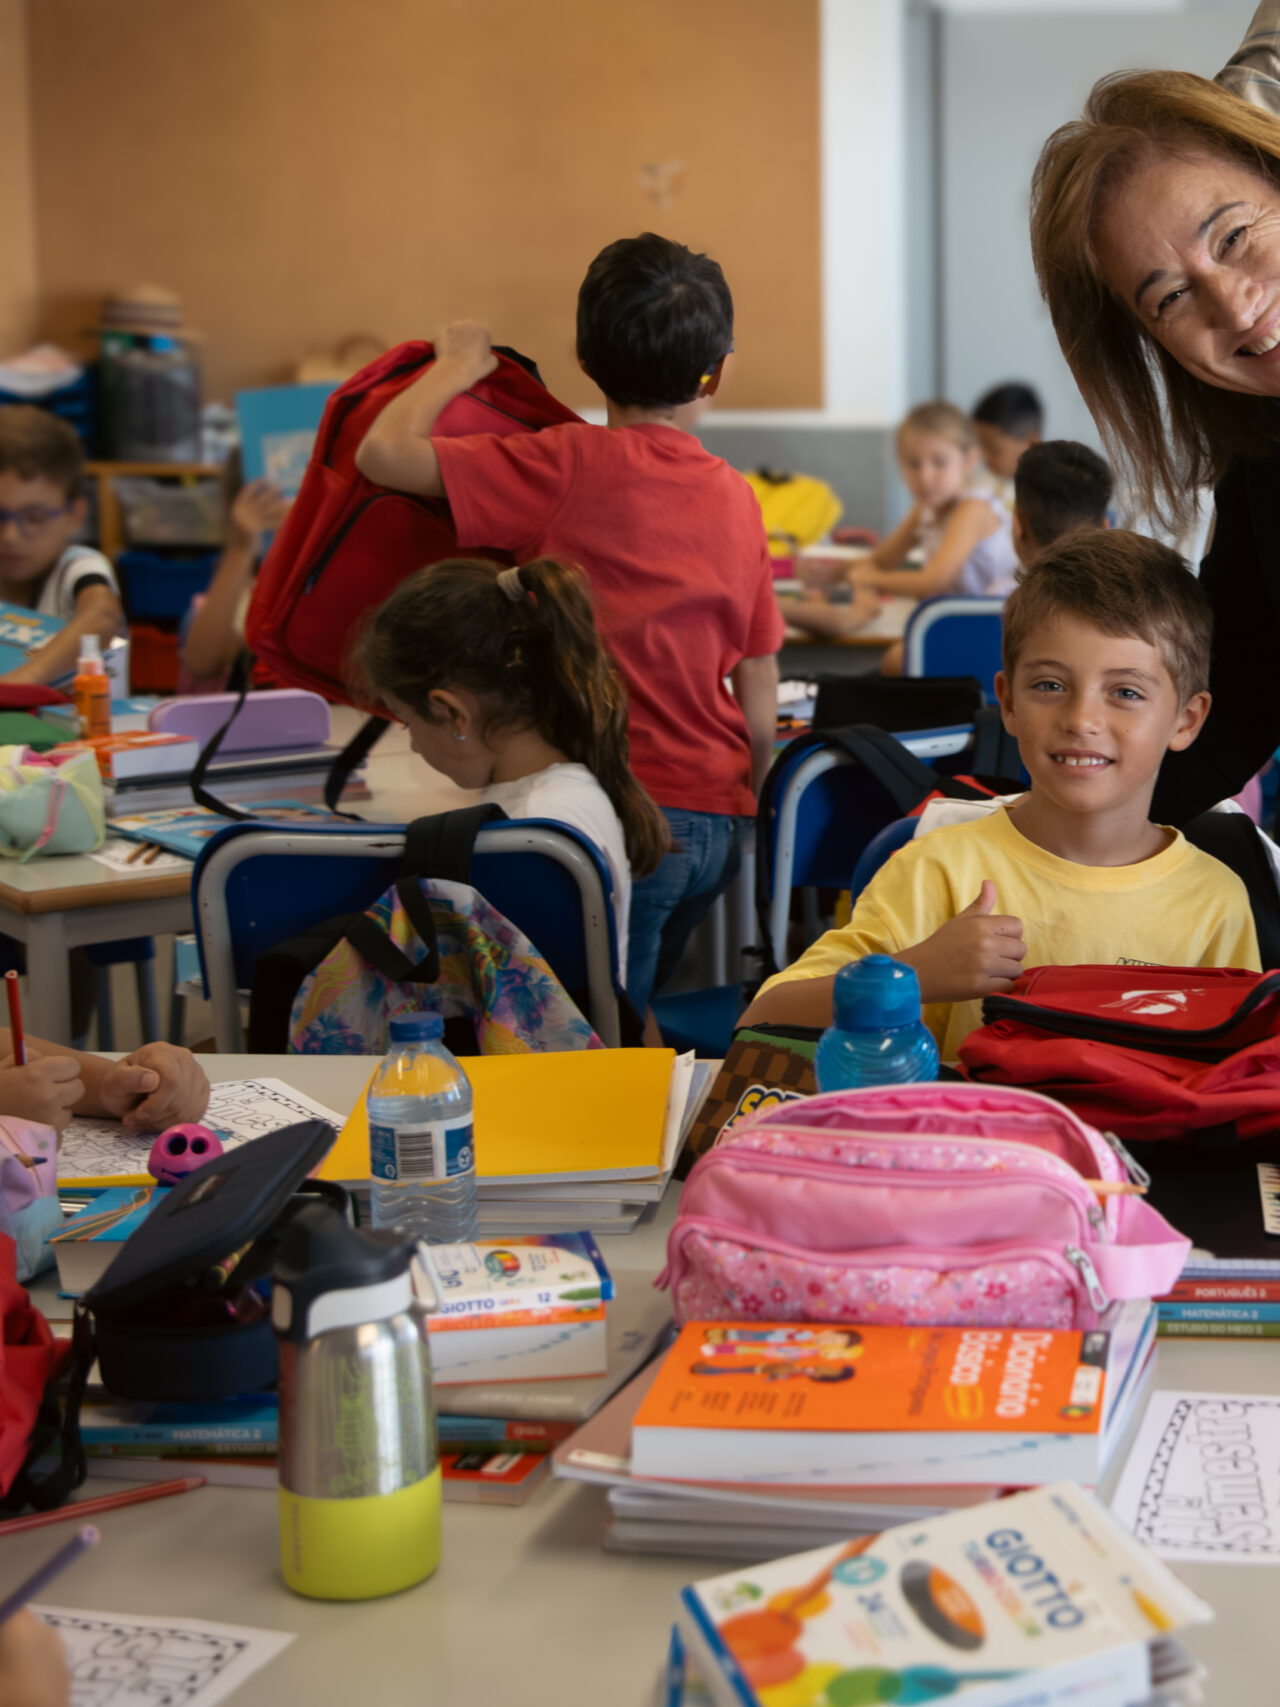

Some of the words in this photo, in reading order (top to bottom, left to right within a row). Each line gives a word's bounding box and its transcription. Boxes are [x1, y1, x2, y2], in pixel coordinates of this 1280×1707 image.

[1181, 1307, 1249, 1319] MATEMÁTICA
[1194, 1286, 1257, 1299] PORTUGUÊS
[949, 1331, 1004, 1386] Básico
[995, 1331, 1054, 1418] Dicionário
[171, 1427, 251, 1440] MATEMÁTICA
[1186, 1402, 1272, 1544] Semestre
[985, 1528, 1085, 1630] GIOTTO
